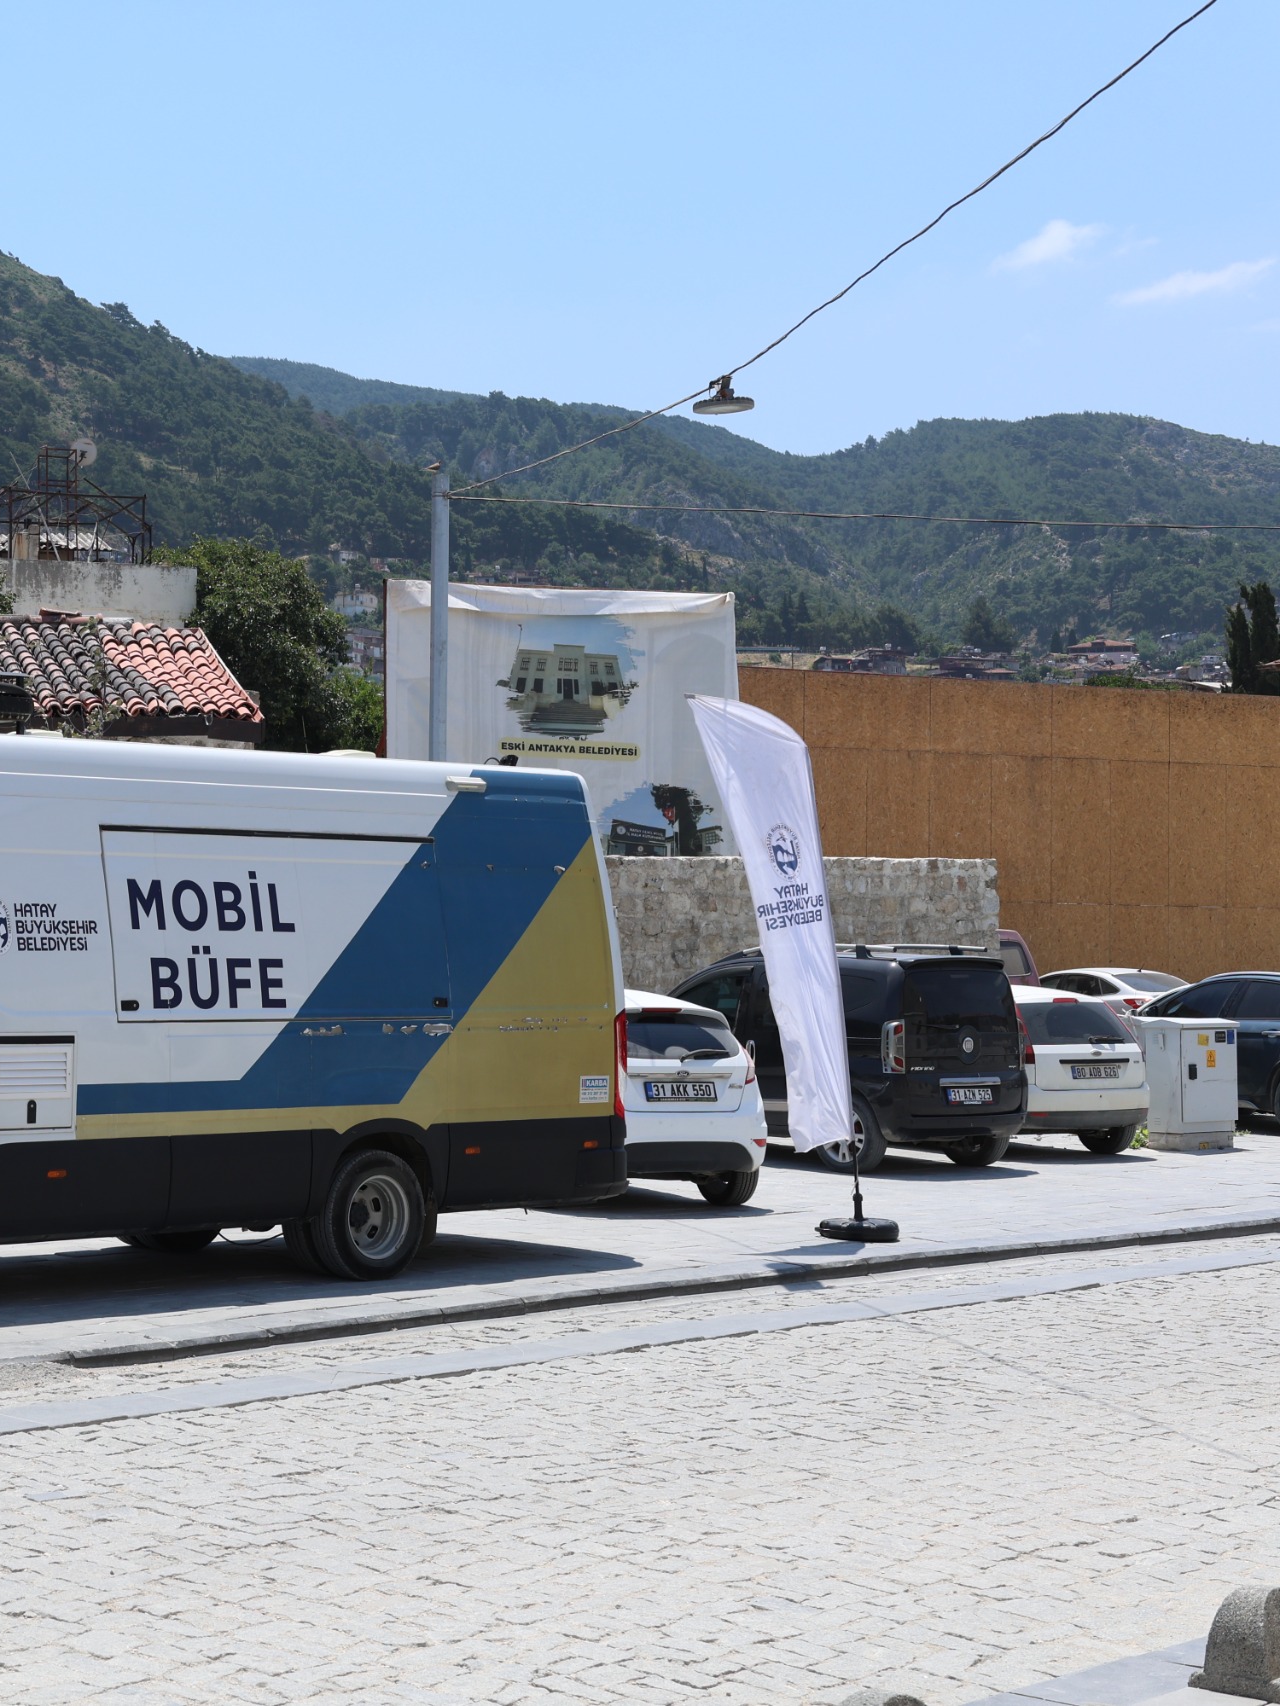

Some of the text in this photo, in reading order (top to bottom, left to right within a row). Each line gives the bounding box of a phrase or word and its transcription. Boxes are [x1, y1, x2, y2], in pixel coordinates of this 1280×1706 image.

[501, 741, 637, 756] ESKİ ANTAKYA BELEDİYESİ
[126, 870, 296, 933] MOBİL
[14, 903, 57, 917] HATAY
[15, 920, 98, 935] BÜYÜKŞEHİR
[17, 937, 88, 951] BELEDİYESİ
[150, 945, 287, 1009] BÜFE
[1104, 1066, 1117, 1077] 626
[586, 1079, 607, 1087] KARBA
[652, 1084, 711, 1097] 31 AKK 550
[952, 1089, 962, 1100] 31
[979, 1089, 991, 1100] 525
